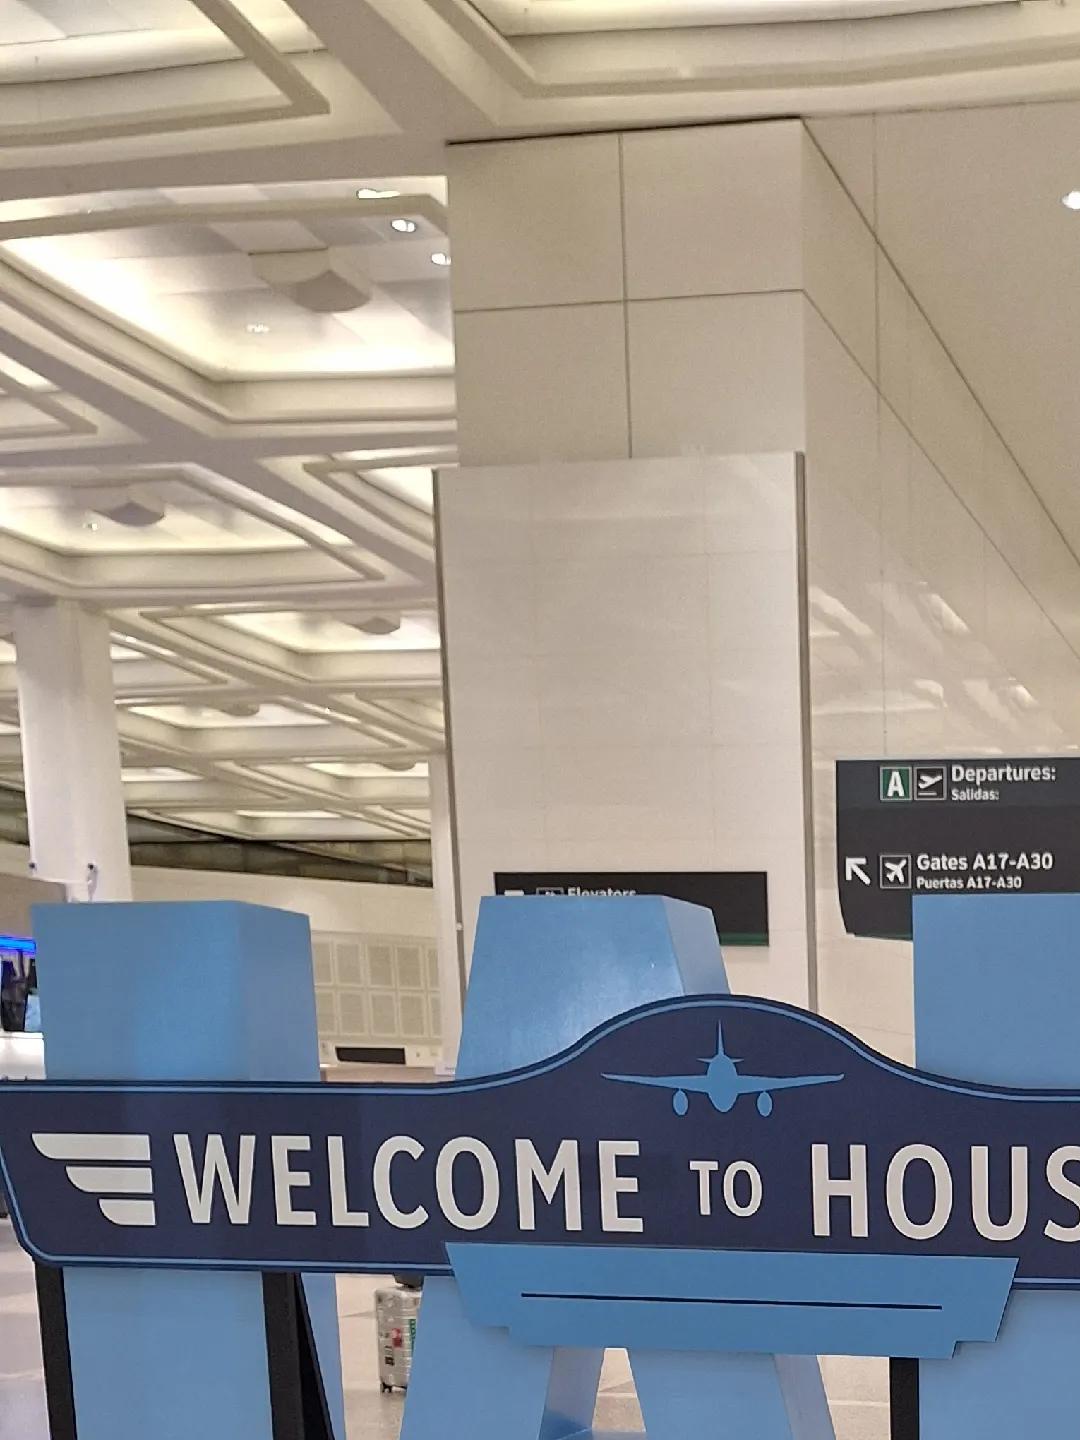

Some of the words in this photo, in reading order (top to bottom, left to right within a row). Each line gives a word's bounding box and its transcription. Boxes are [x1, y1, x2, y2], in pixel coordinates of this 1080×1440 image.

[951, 764, 1057, 784] Departures:
[887, 771, 906, 798] A
[951, 787, 1000, 800] Salidas:
[917, 853, 968, 871] Gates
[972, 852, 1054, 871] A17-A30
[917, 876, 964, 889] Puertas
[967, 875, 1022, 889] A17-A30
[172, 1132, 644, 1234] WELCOME
[689, 1159, 763, 1218] TO
